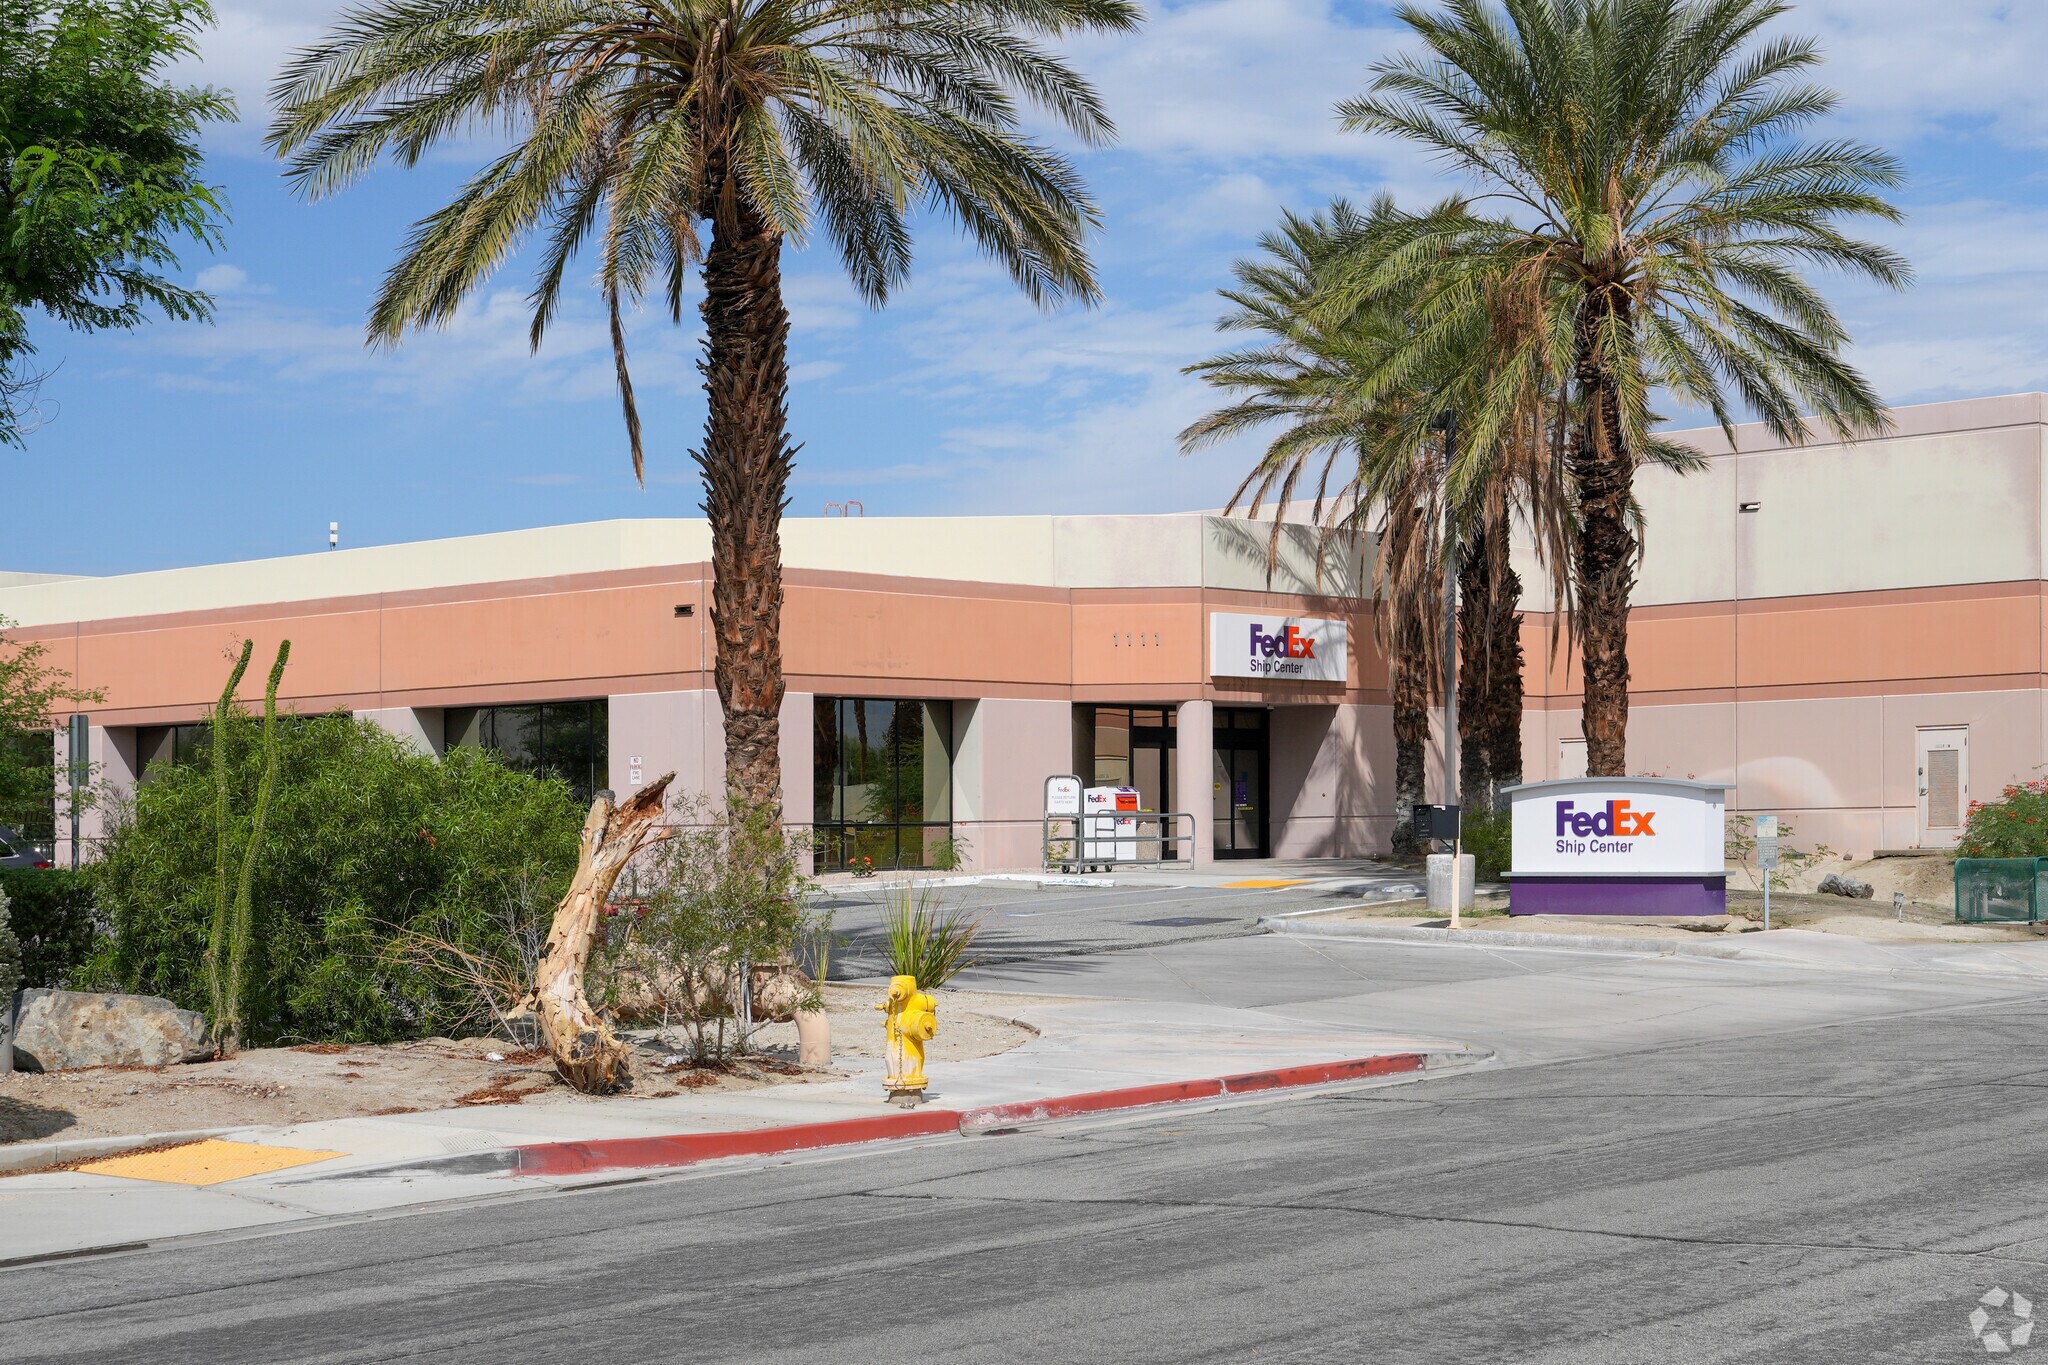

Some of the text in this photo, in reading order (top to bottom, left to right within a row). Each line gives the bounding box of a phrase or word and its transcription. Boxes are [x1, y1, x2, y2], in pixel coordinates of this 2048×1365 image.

[1250, 623, 1316, 659] FedEx
[1250, 659, 1303, 675] Ship Center
[1088, 794, 1107, 803] FedEx
[1116, 816, 1132, 825] edEx
[1556, 799, 1656, 837] FedEx
[1556, 839, 1633, 856] Ship Center
